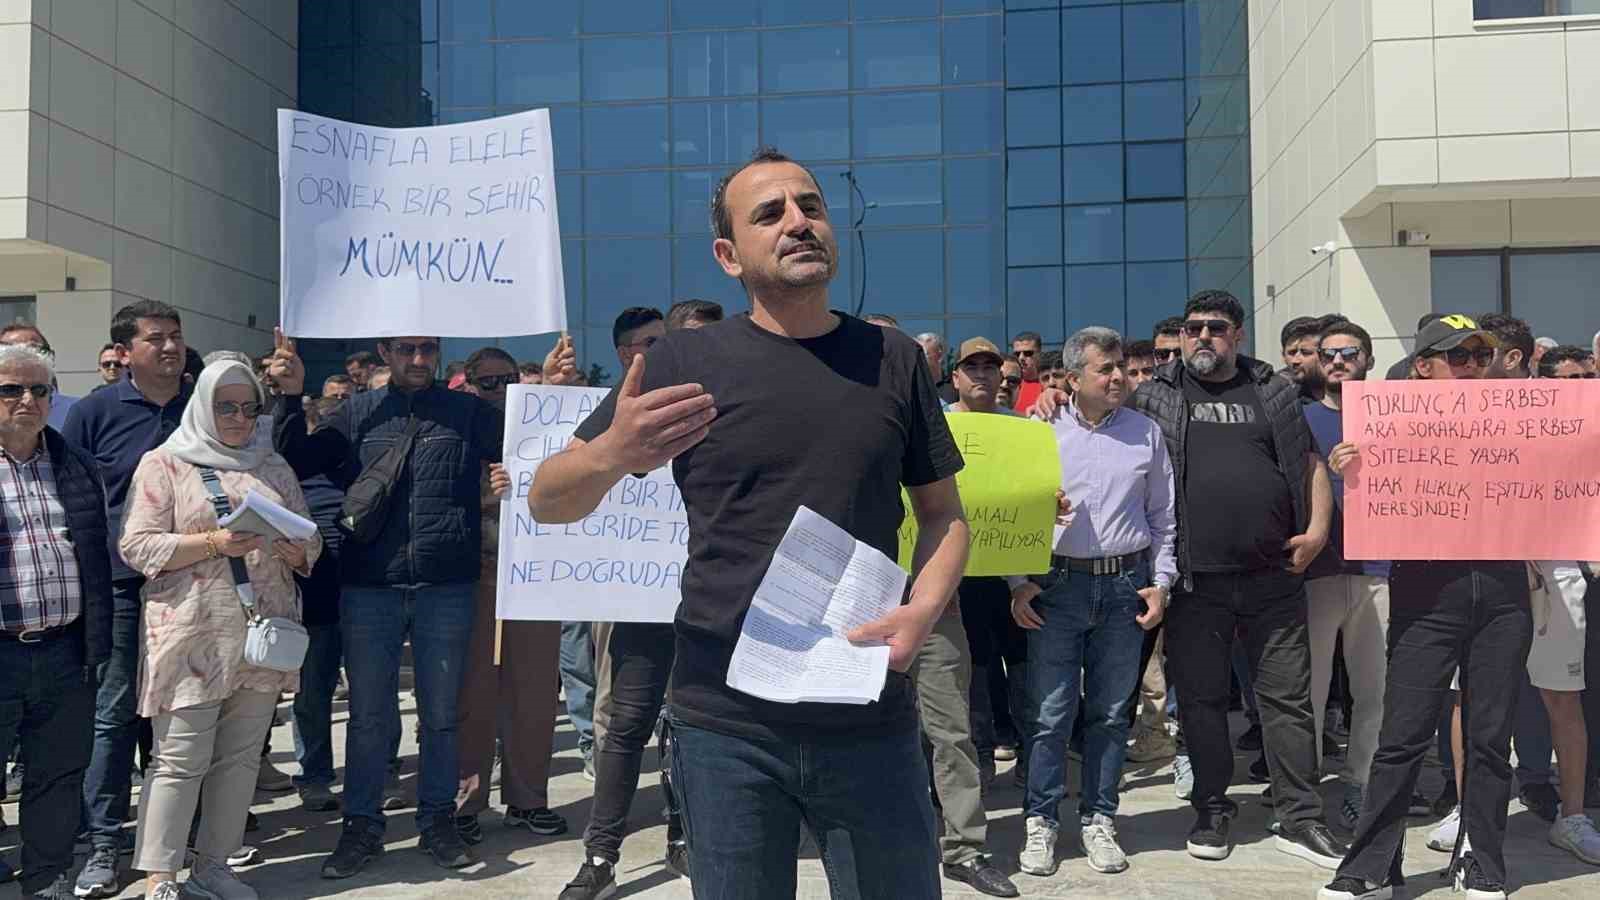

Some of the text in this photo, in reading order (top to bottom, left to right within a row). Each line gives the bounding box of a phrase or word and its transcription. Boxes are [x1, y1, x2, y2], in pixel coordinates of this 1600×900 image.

[290, 117, 537, 167] ESNAFLA ELELE
[297, 172, 392, 213] ÖRNEK
[1479, 387, 1561, 413] SERBEST
[1364, 417, 1585, 441] ARA SOKAKLARA SERBEST
[1469, 446, 1521, 465] YASAK
[1367, 476, 1403, 496] HAK
[1414, 478, 1472, 502] HUKUK
[510, 559, 545, 585] NE
